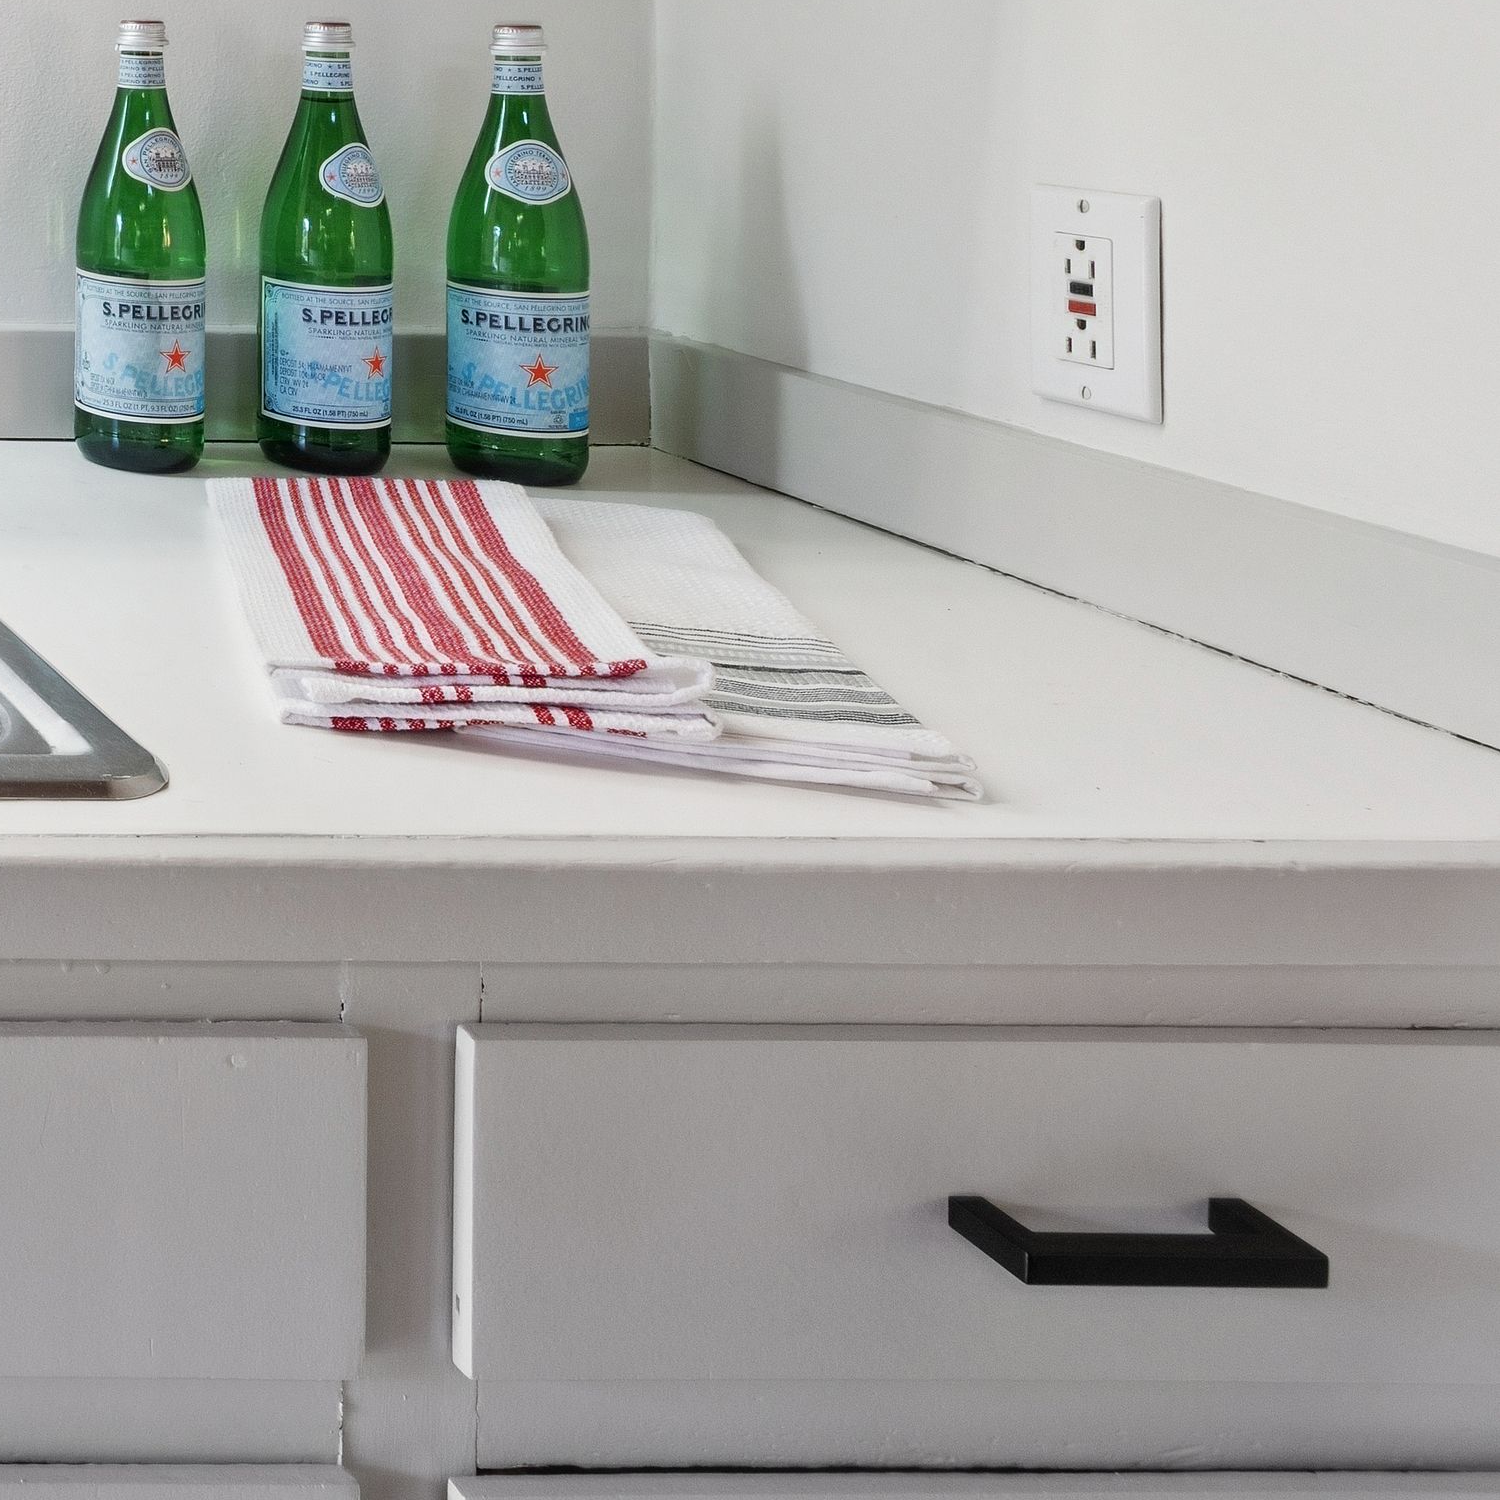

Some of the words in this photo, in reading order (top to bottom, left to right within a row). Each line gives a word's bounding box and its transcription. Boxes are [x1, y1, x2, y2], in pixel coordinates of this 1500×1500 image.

[102, 301, 206, 320] S.PELLEGRI
[308, 327, 352, 337] SPARKLING
[465, 328, 507, 341] SPARKLING
[510, 335, 548, 344] NATURAL
